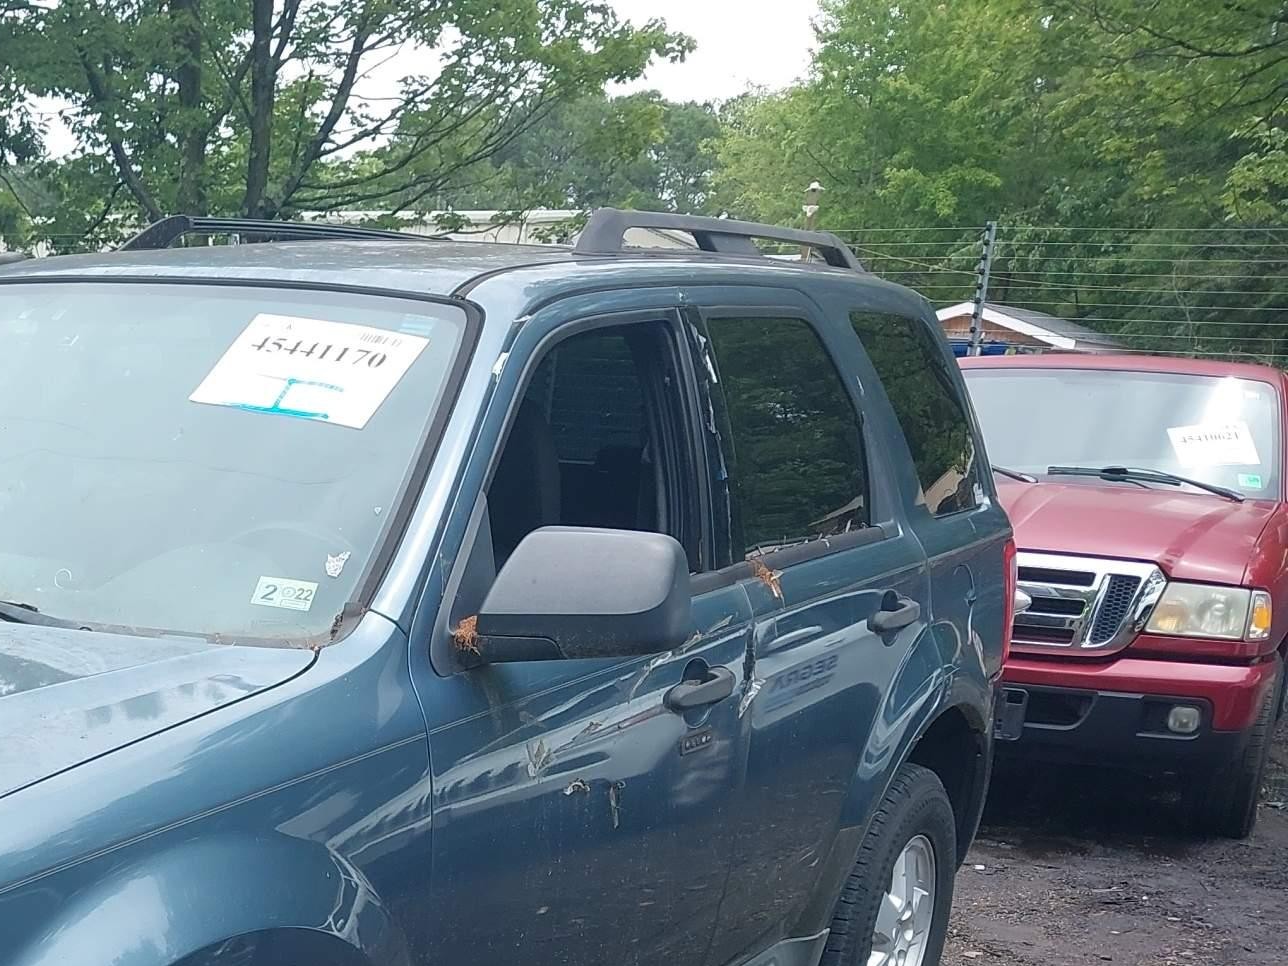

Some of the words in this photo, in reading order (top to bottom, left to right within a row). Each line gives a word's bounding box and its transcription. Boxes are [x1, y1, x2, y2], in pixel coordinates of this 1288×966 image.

[252, 335, 388, 369] 45441170
[260, 584, 278, 601] 2
[294, 587, 313, 602] 22
